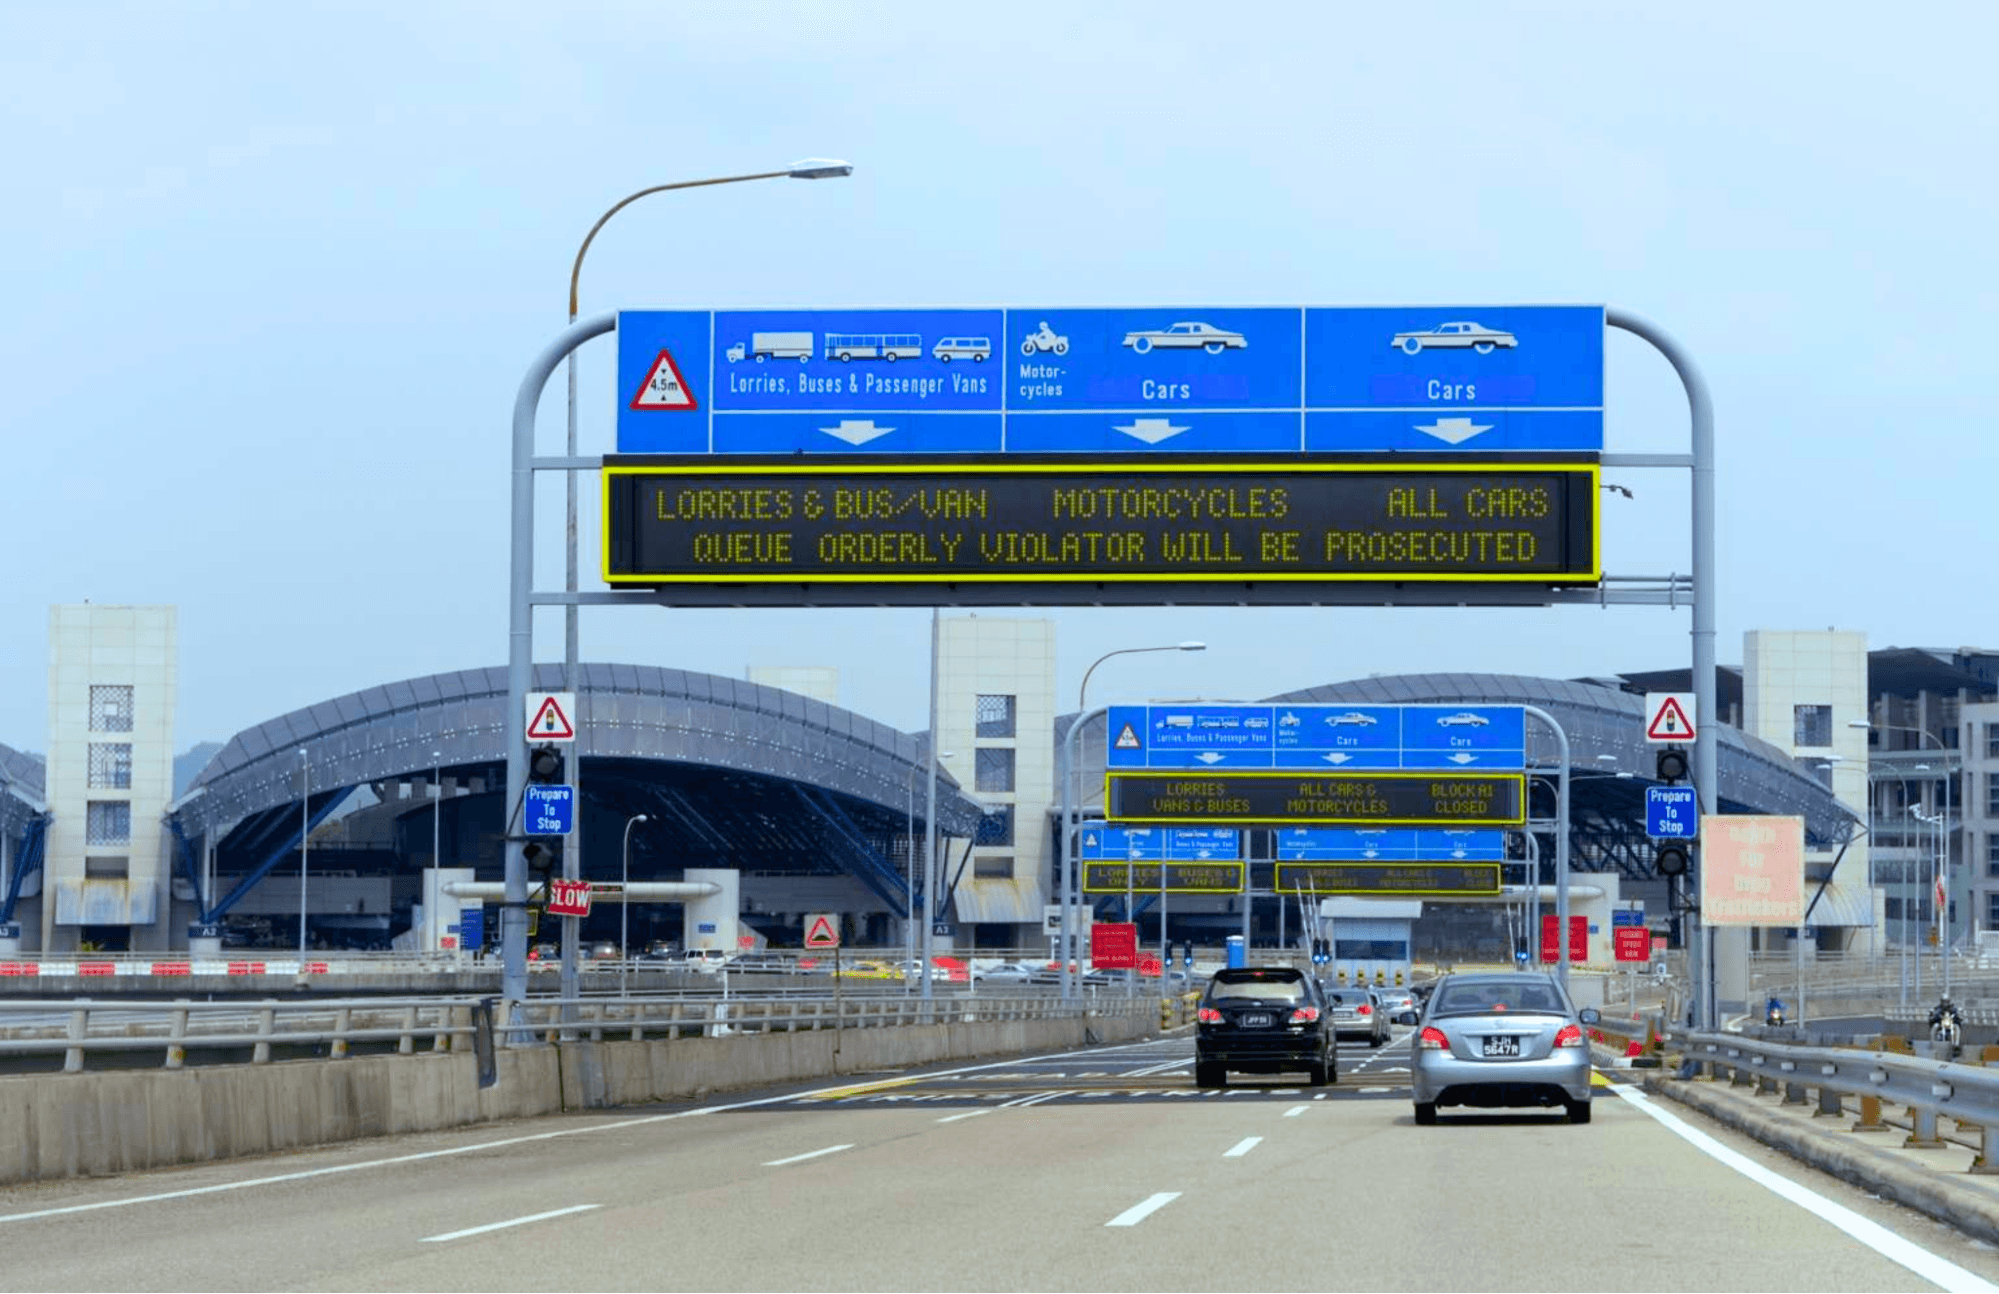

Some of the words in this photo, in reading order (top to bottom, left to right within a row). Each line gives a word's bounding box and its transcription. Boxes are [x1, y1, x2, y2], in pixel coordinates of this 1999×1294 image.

[1020, 364, 1067, 379] Motor-
[651, 378, 678, 391] 4.5m
[729, 372, 791, 396] Lorries,
[799, 372, 842, 394] Buses
[849, 372, 858, 394] &
[866, 372, 944, 398] Passenger
[952, 372, 987, 394] Vans
[1020, 382, 1063, 400] cycles
[1142, 379, 1190, 400] Cars
[1427, 379, 1476, 400] Cars
[657, 488, 793, 519] LORRIES
[804, 488, 824, 519] &
[833, 488, 988, 519] BUS/VAN
[1053, 488, 1288, 518] MOTORCYCLES
[1388, 488, 1447, 517] ALL
[1467, 488, 1548, 517] CARS
[693, 533, 793, 562] QUEUE
[819, 533, 963, 562] ORDERLY
[980, 532, 1145, 562] VIOLATOR
[1162, 532, 1242, 561] WILL
[1261, 532, 1300, 561] BE
[1327, 532, 1536, 561] PROSECUTED
[1186, 733, 1206, 743] Buses
[1215, 733, 1249, 744] Passenger
[1252, 733, 1267, 742] Vans
[1337, 736, 1358, 746] Cars
[1450, 736, 1472, 746] Cars
[529, 787, 570, 802] Prepare
[1166, 783, 1225, 796] LORRIES
[1300, 783, 1327, 797] ALL
[1329, 783, 1363, 797] CARS
[1431, 783, 1476, 797] BLOCK
[1651, 789, 1691, 804] Prepare
[543, 803, 556, 816] To
[1153, 800, 1191, 812] VANS
[1208, 800, 1250, 812] BUSES
[1287, 801, 1388, 813] MOTORCYCLES
[1435, 800, 1488, 813] CLOSED
[1665, 806, 1677, 819] To
[537, 817, 562, 832] Stop
[1659, 820, 1683, 835] Stop
